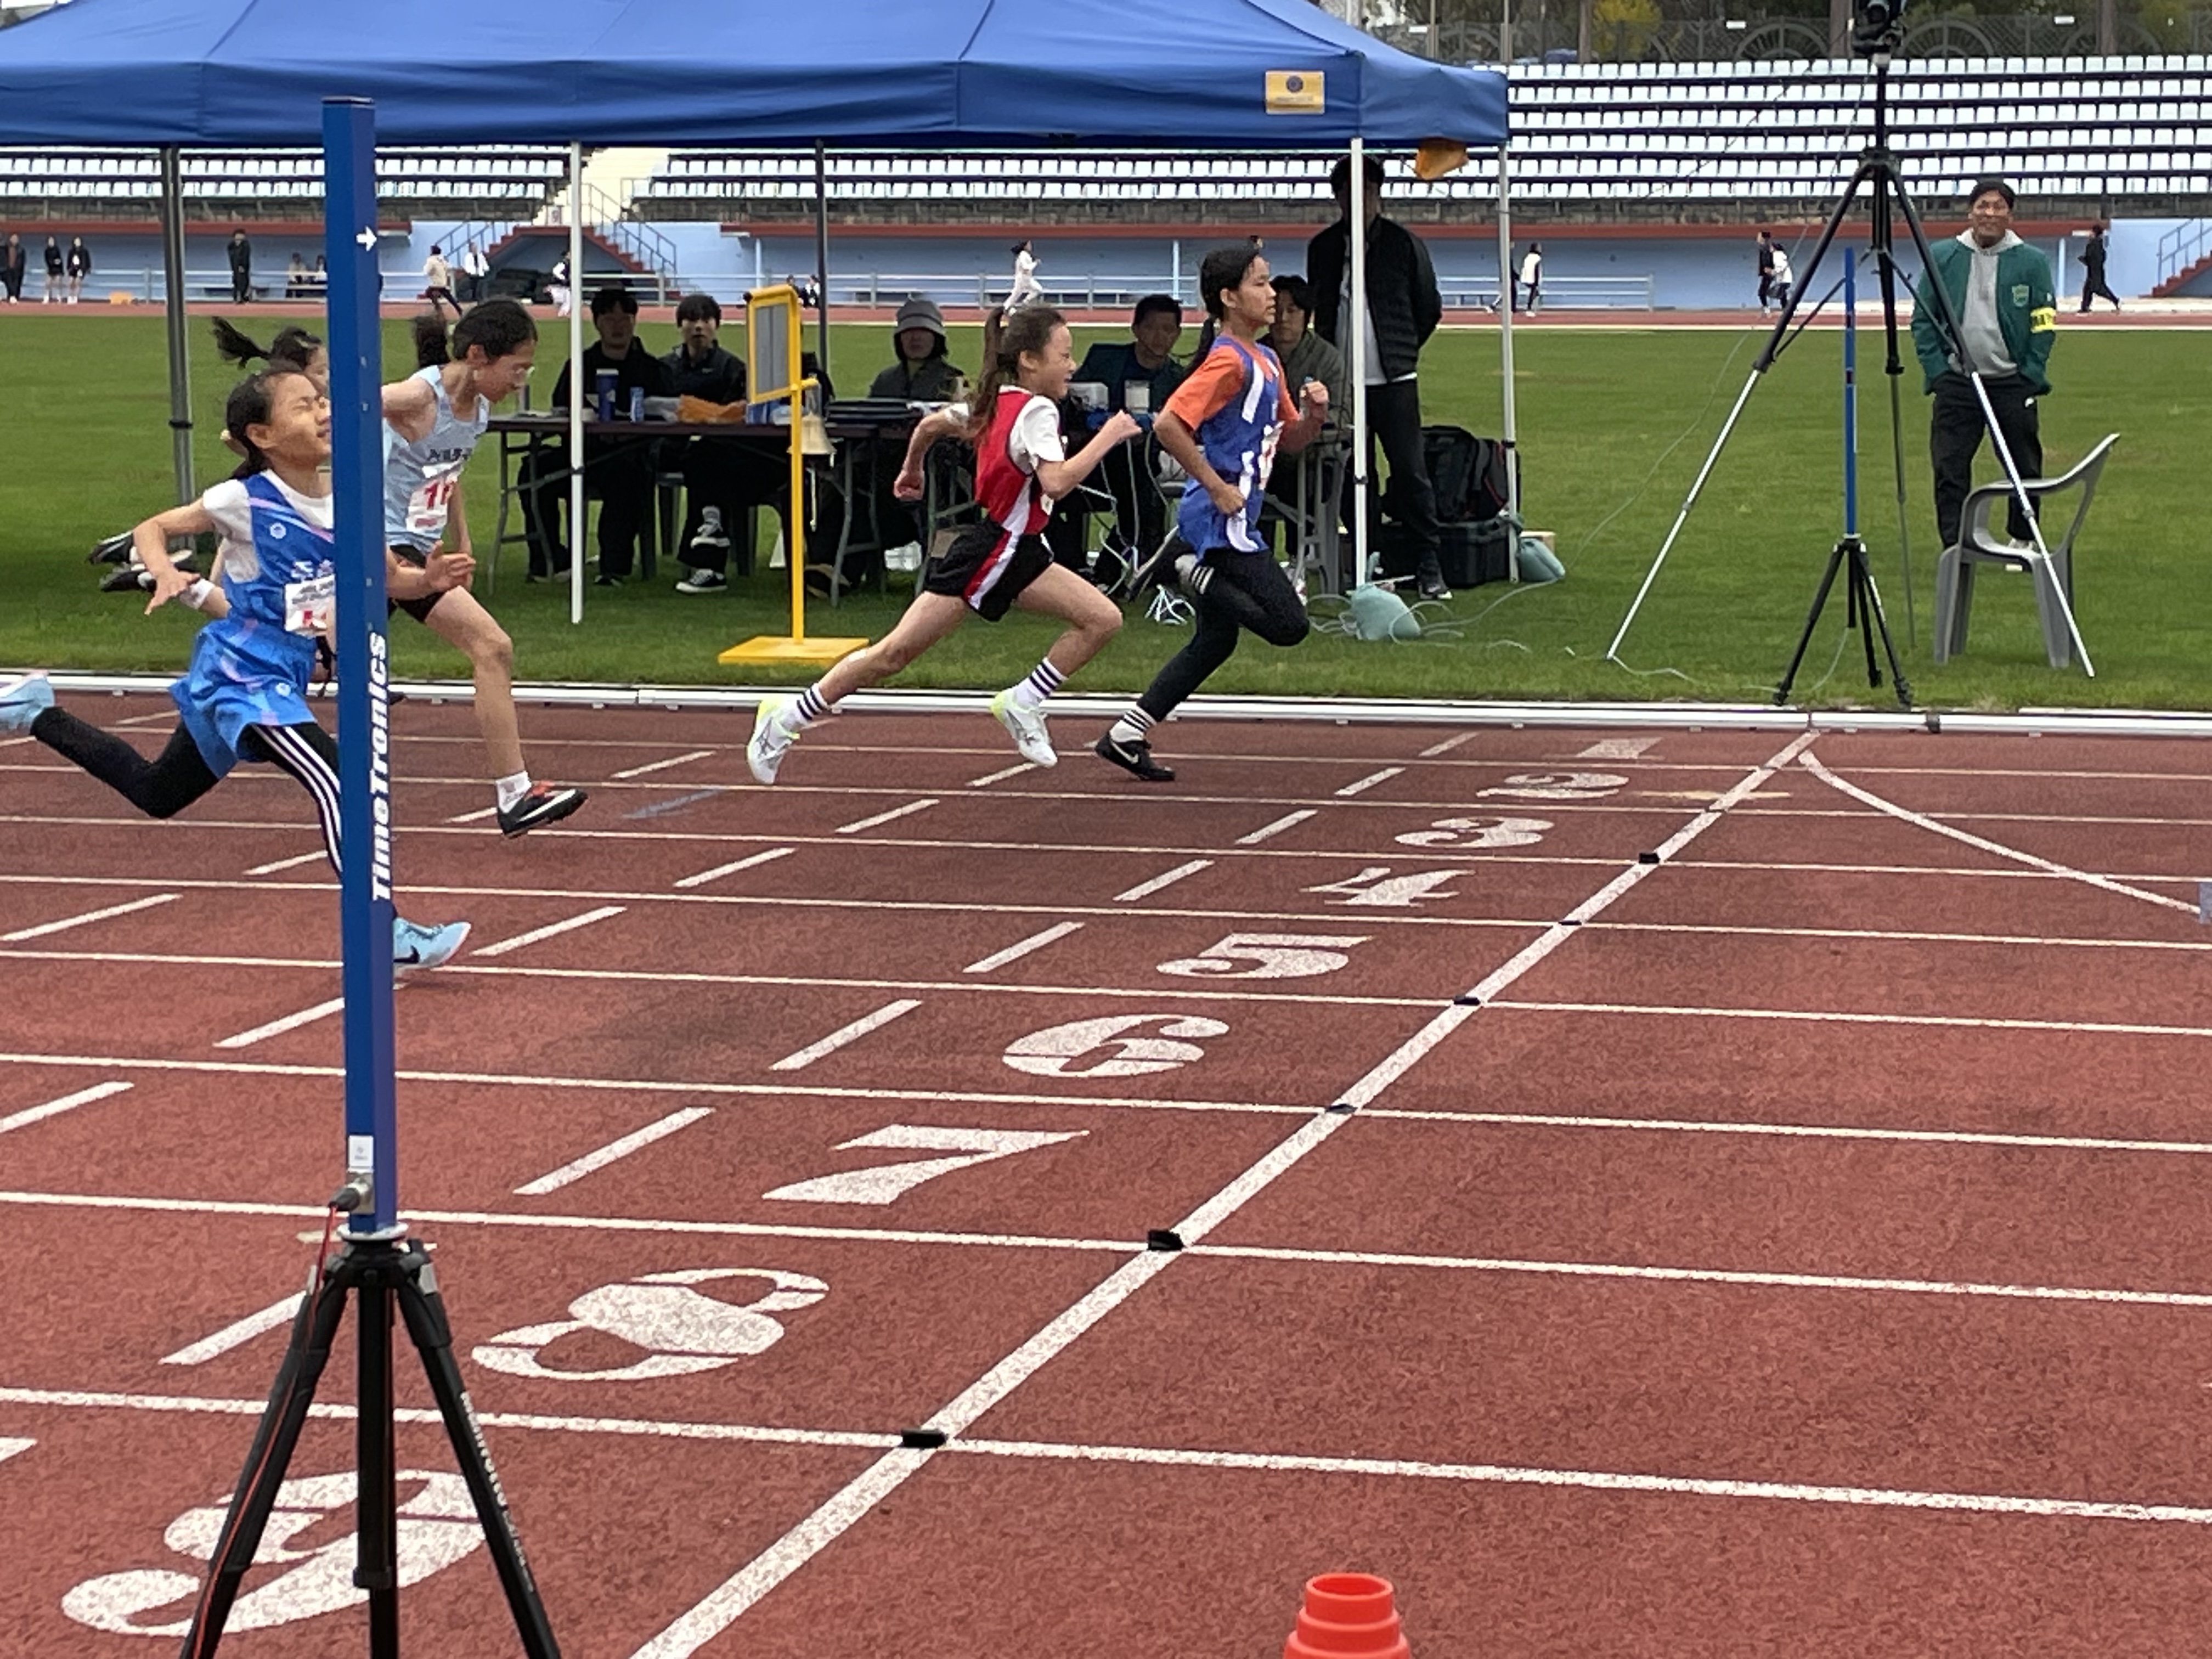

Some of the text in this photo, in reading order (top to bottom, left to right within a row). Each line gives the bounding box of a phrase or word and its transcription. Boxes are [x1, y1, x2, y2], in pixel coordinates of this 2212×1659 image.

[1475, 771, 1629, 799] 2
[1394, 816, 1555, 848] 3
[1302, 867, 1475, 906] 4
[1156, 933, 1371, 979] 5
[1002, 1013, 1229, 1078] 6
[761, 1124, 1090, 1205] 7
[471, 1267, 830, 1381] 8
[61, 1469, 486, 1637] 9
